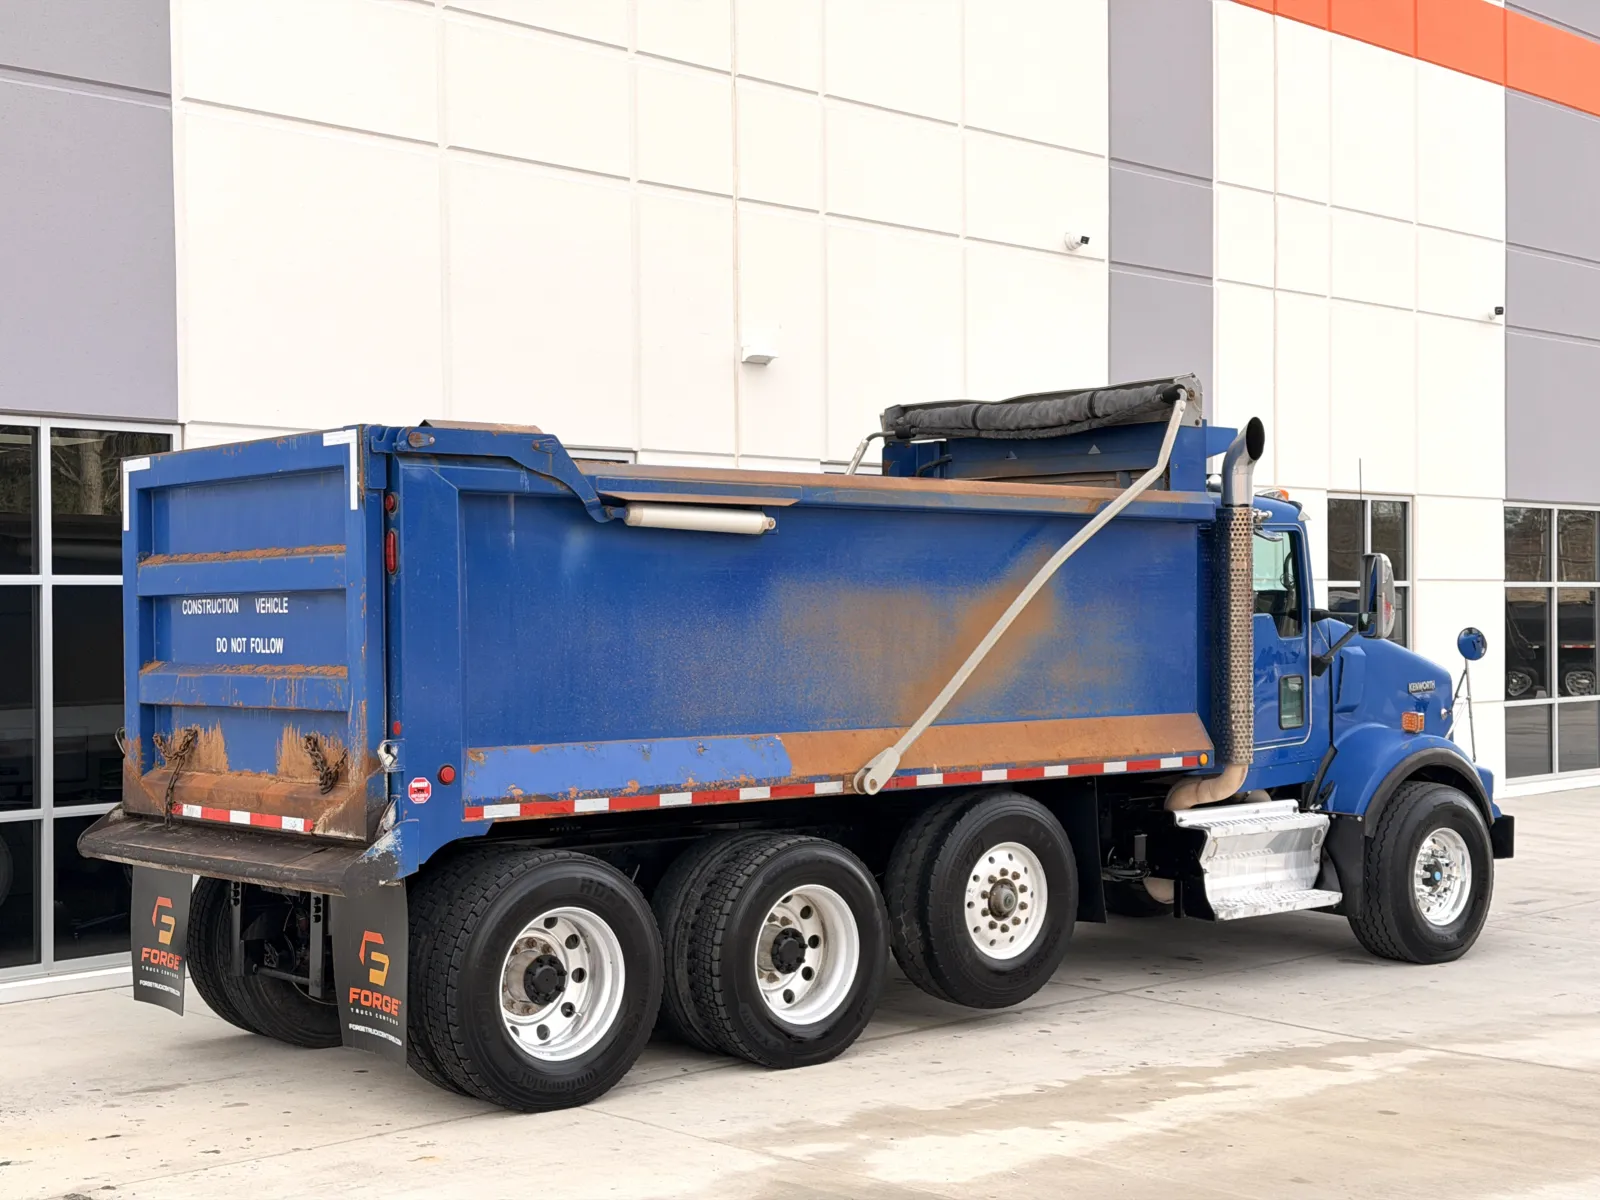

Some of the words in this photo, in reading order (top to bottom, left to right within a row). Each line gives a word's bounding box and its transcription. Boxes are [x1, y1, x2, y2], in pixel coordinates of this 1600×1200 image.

[182, 598, 239, 615] CONSTRUCTION
[255, 597, 289, 614] VEHICLE
[216, 637, 228, 653] DO
[230, 637, 247, 653] NOT
[250, 637, 284, 654] FOLLOW
[1408, 680, 1436, 692] KENWORTH
[141, 947, 180, 971] FORGE
[349, 987, 400, 1017] FORGE
